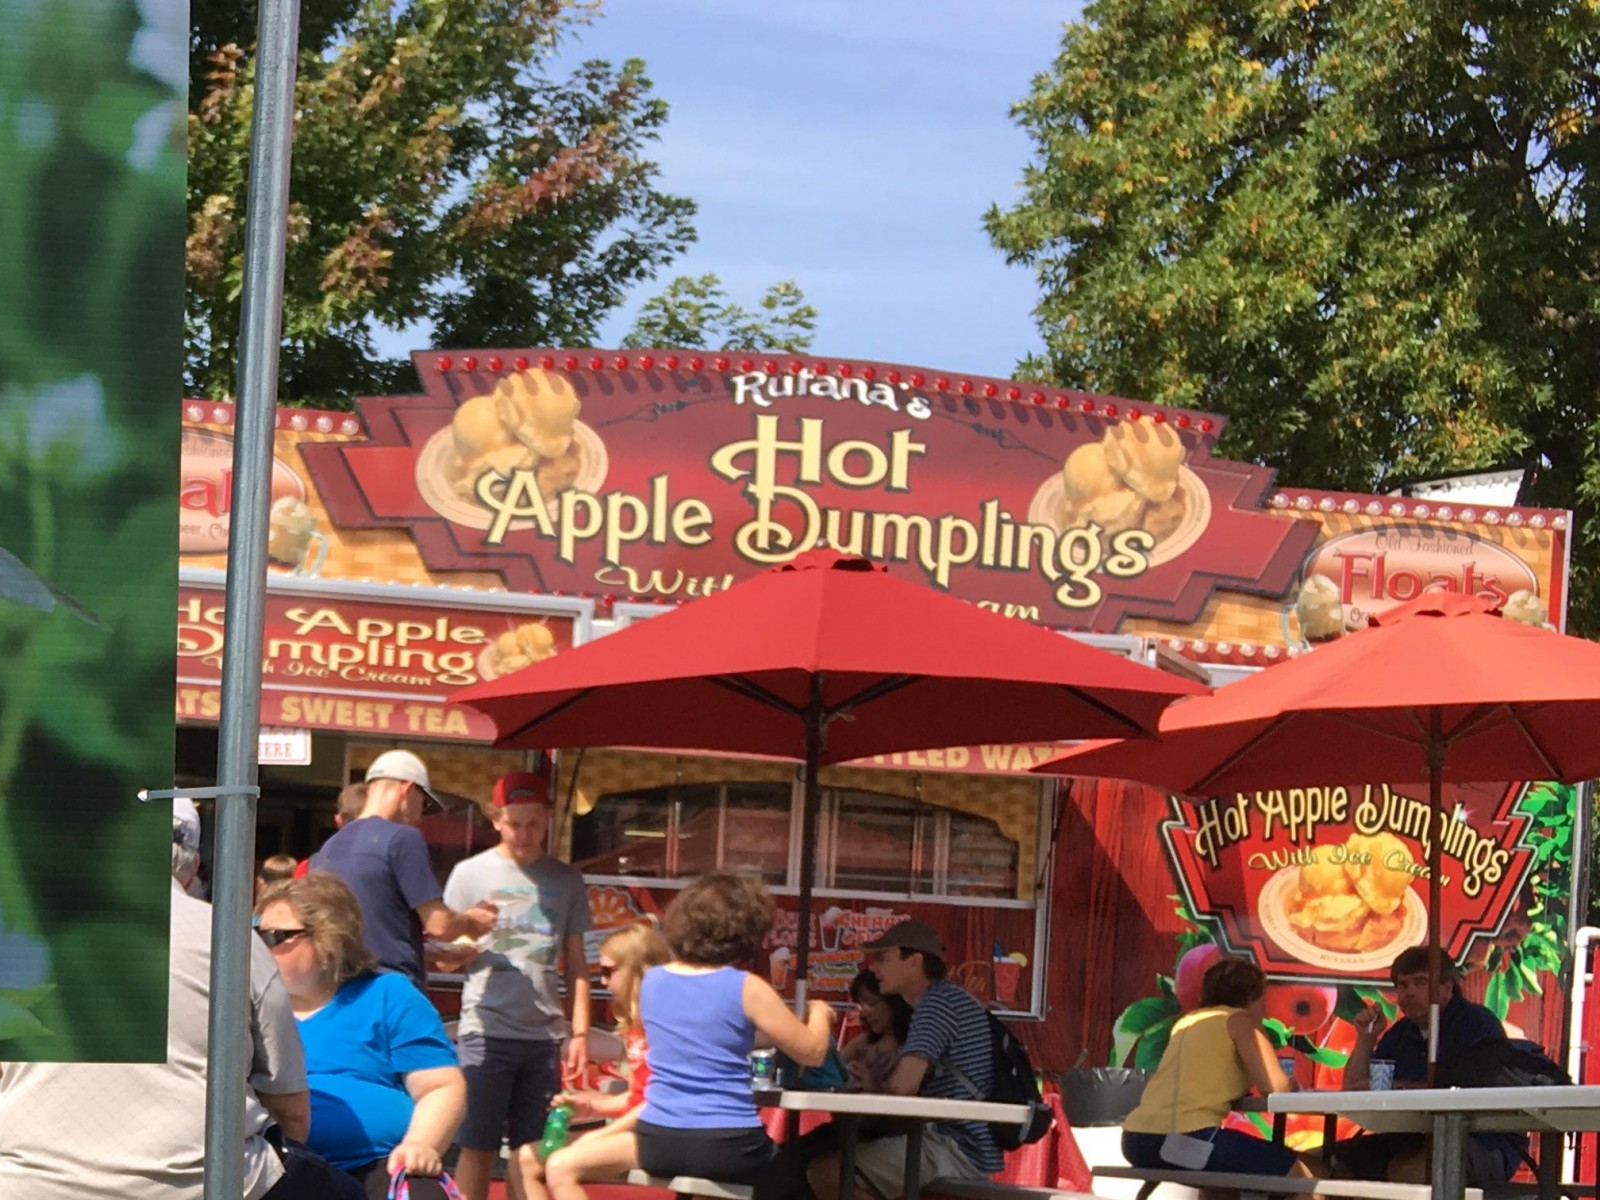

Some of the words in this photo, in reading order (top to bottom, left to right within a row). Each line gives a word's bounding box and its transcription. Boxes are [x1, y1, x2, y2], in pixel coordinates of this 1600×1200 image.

[730, 367, 933, 420] Rutana's
[710, 413, 927, 492] Hot
[475, 468, 713, 567] Apple
[735, 483, 1155, 609] Dumplings
[1332, 548, 1508, 611] Floats
[284, 606, 487, 647] Apple
[340, 664, 434, 687] Cream
[279, 695, 394, 730] SWEET
[404, 706, 470, 735] TEA
[1194, 792, 1249, 868] Hot
[1256, 784, 1348, 842] Apple
[1247, 845, 1318, 873] With
[1327, 843, 1372, 866] Ice
